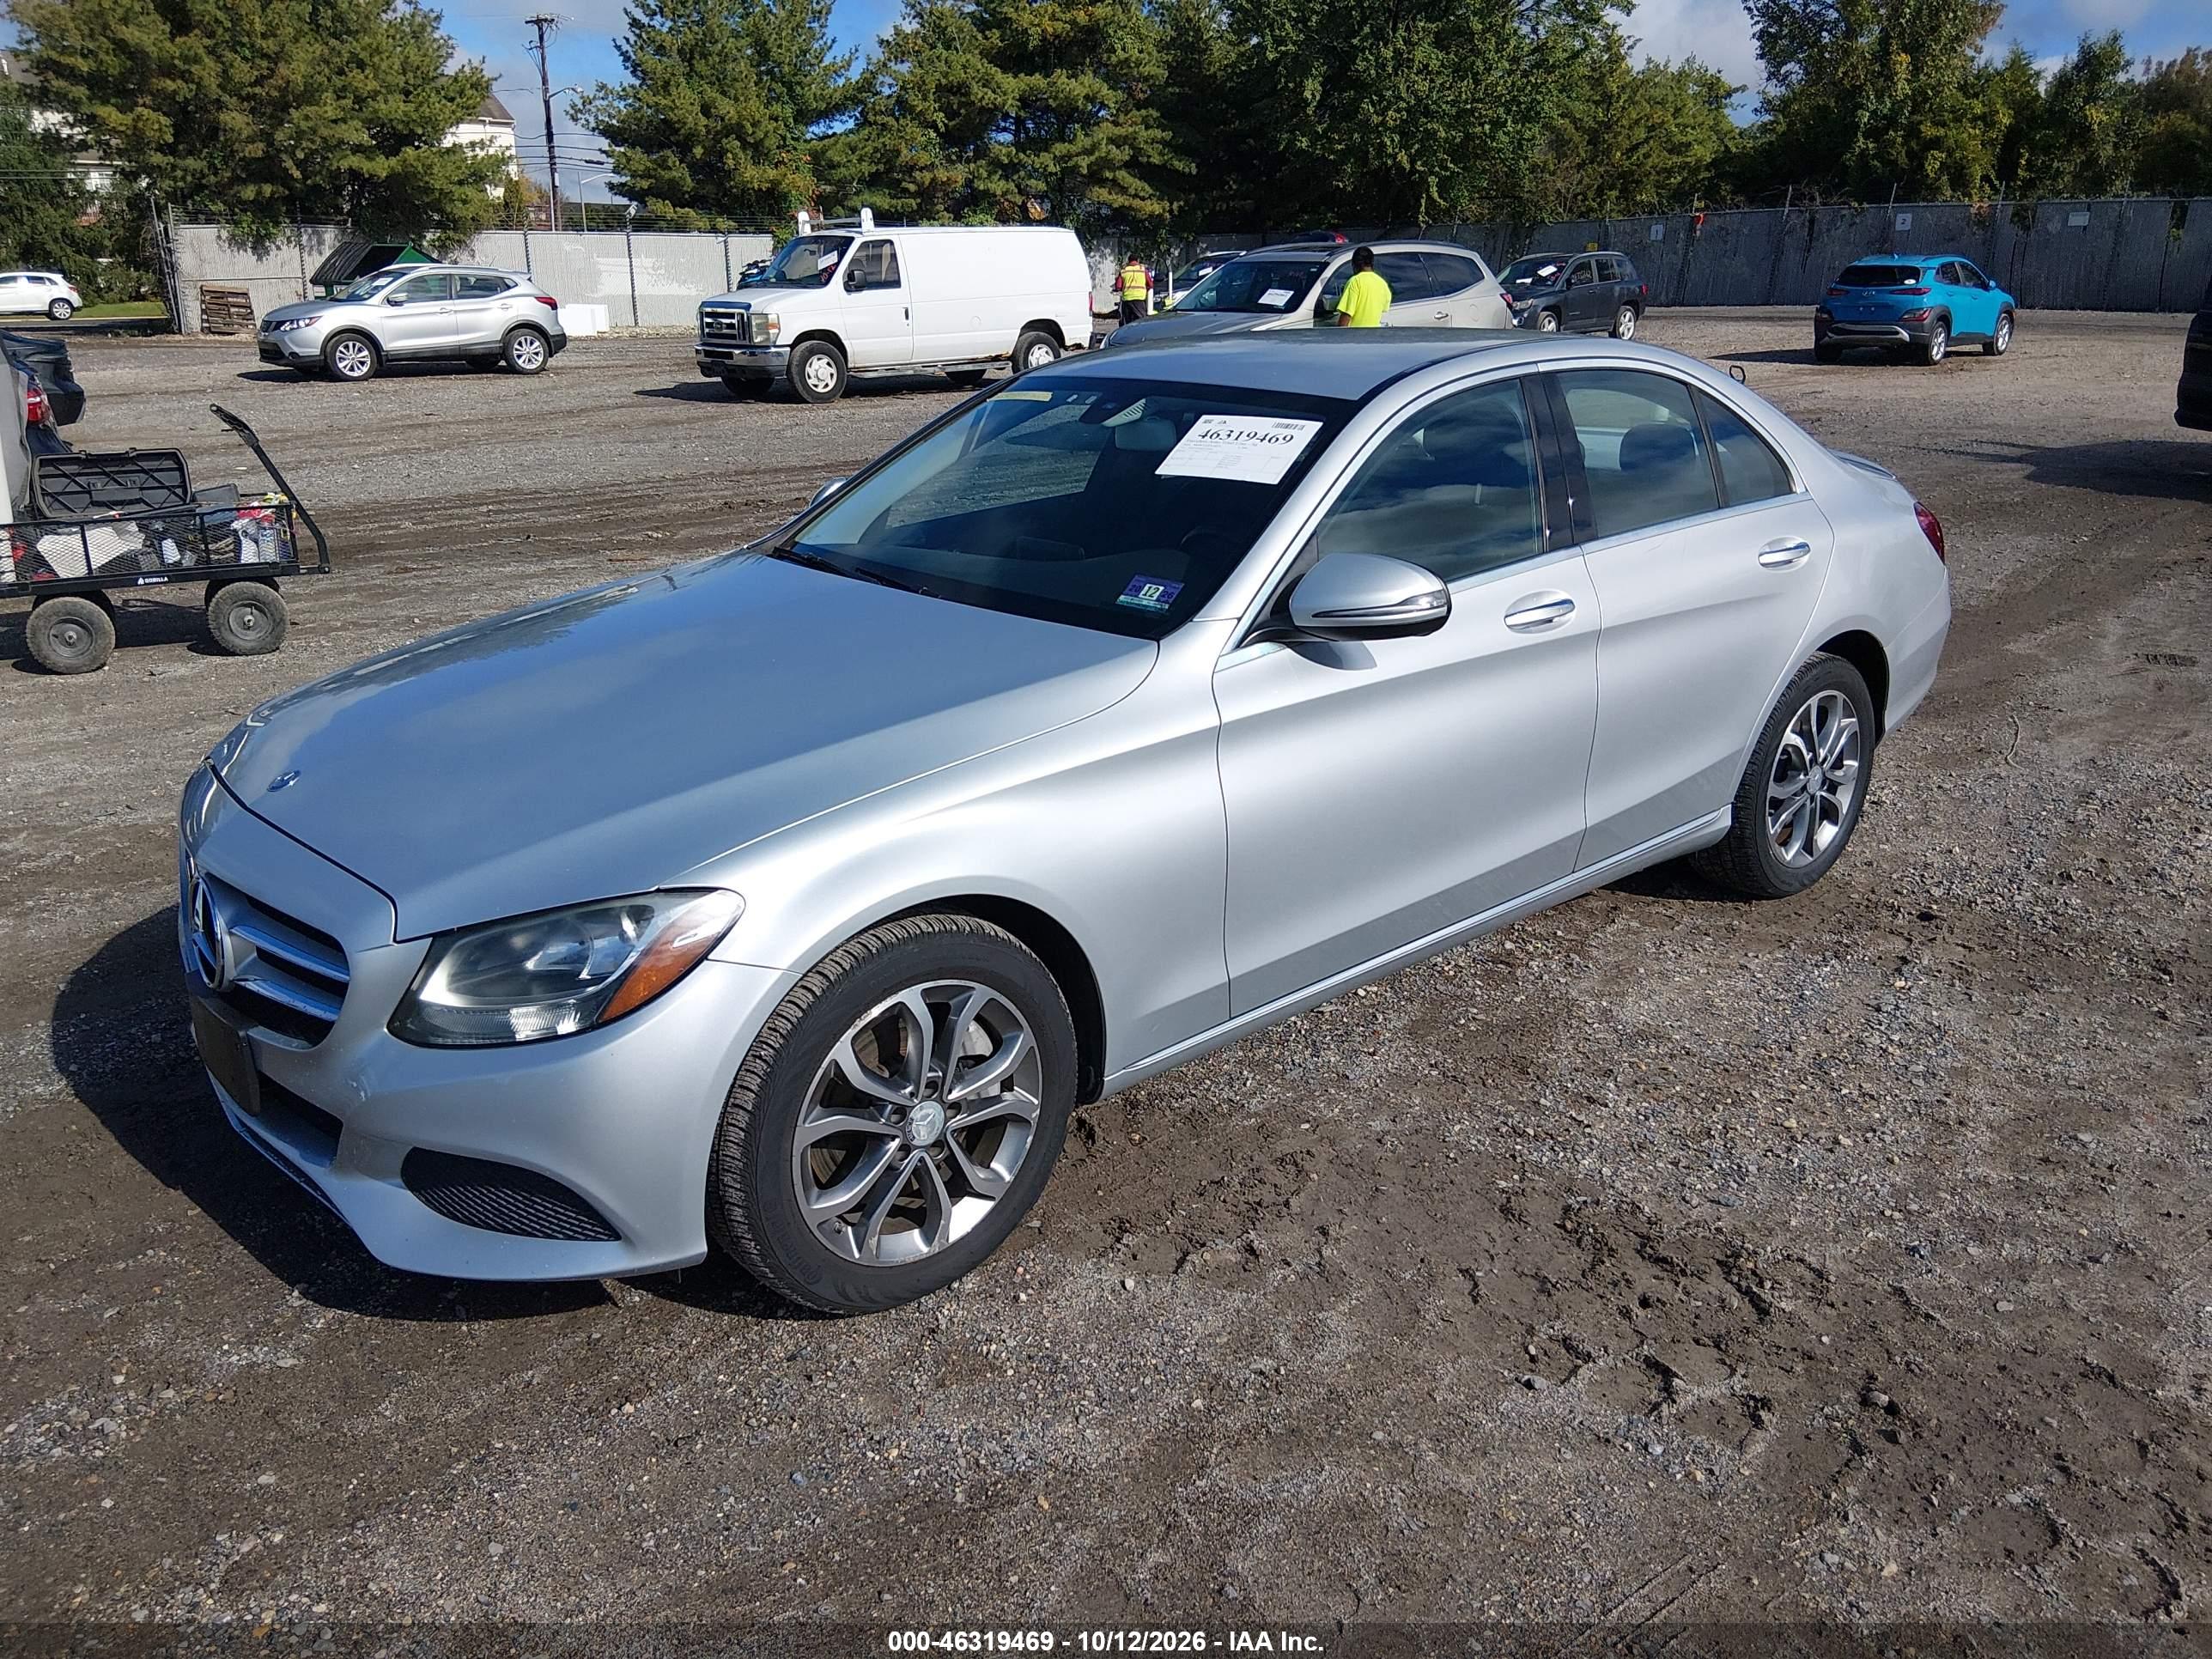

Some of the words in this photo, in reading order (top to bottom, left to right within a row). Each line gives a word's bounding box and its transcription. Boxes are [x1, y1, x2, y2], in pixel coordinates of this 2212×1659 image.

[1197, 428, 1295, 446] 46319469
[1142, 586, 1160, 599] 12
[1160, 590, 1176, 599] 26
